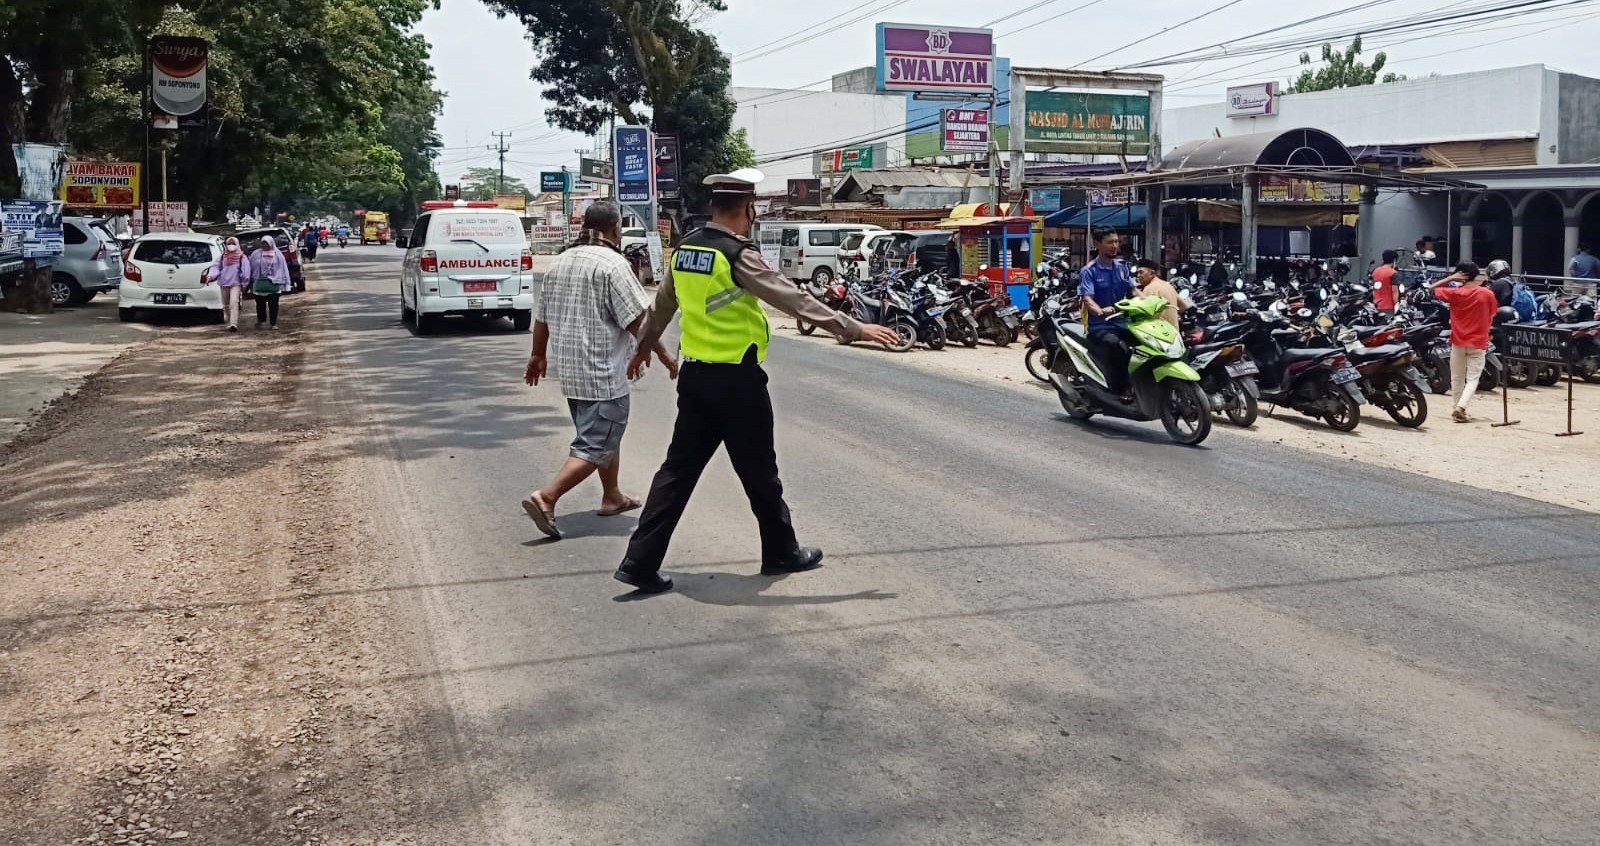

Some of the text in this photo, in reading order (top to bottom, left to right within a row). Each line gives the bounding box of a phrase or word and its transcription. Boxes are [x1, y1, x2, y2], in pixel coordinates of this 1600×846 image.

[932, 34, 947, 49] BD
[153, 40, 200, 61] Surya
[889, 57, 988, 83] SWALAYAN
[958, 111, 976, 121] BMT
[1028, 111, 1145, 130] MASJID AL MUHAJIRIN
[98, 165, 135, 176] BAKAR
[71, 176, 130, 185] SOPONYONO
[439, 259, 519, 269] AMBULANCE
[676, 249, 714, 273] POLISI
[1515, 330, 1560, 347] PARKIR
